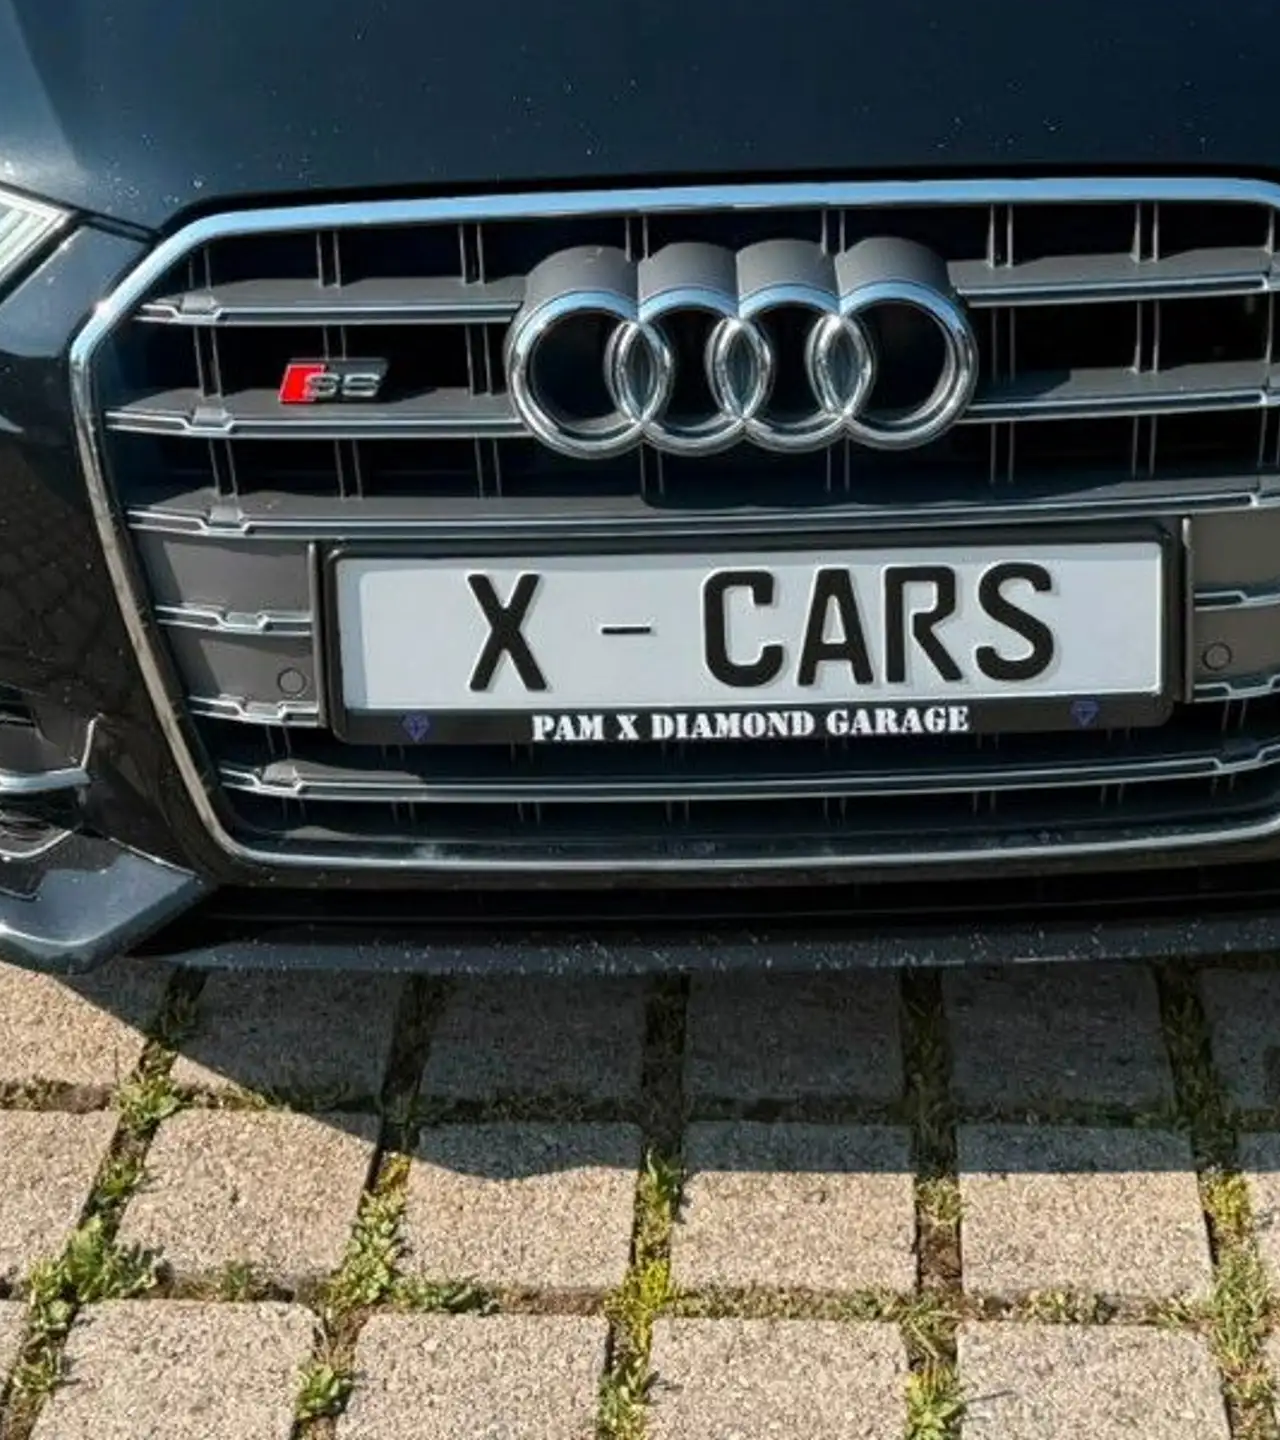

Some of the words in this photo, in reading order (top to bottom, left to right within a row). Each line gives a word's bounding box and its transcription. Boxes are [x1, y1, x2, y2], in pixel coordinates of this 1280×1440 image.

[467, 573, 548, 691] X
[703, 562, 1055, 687] CARS
[531, 714, 604, 741] PAM
[617, 713, 640, 741] X
[651, 711, 815, 740] DIAMOND
[826, 706, 970, 737] GARAGE
